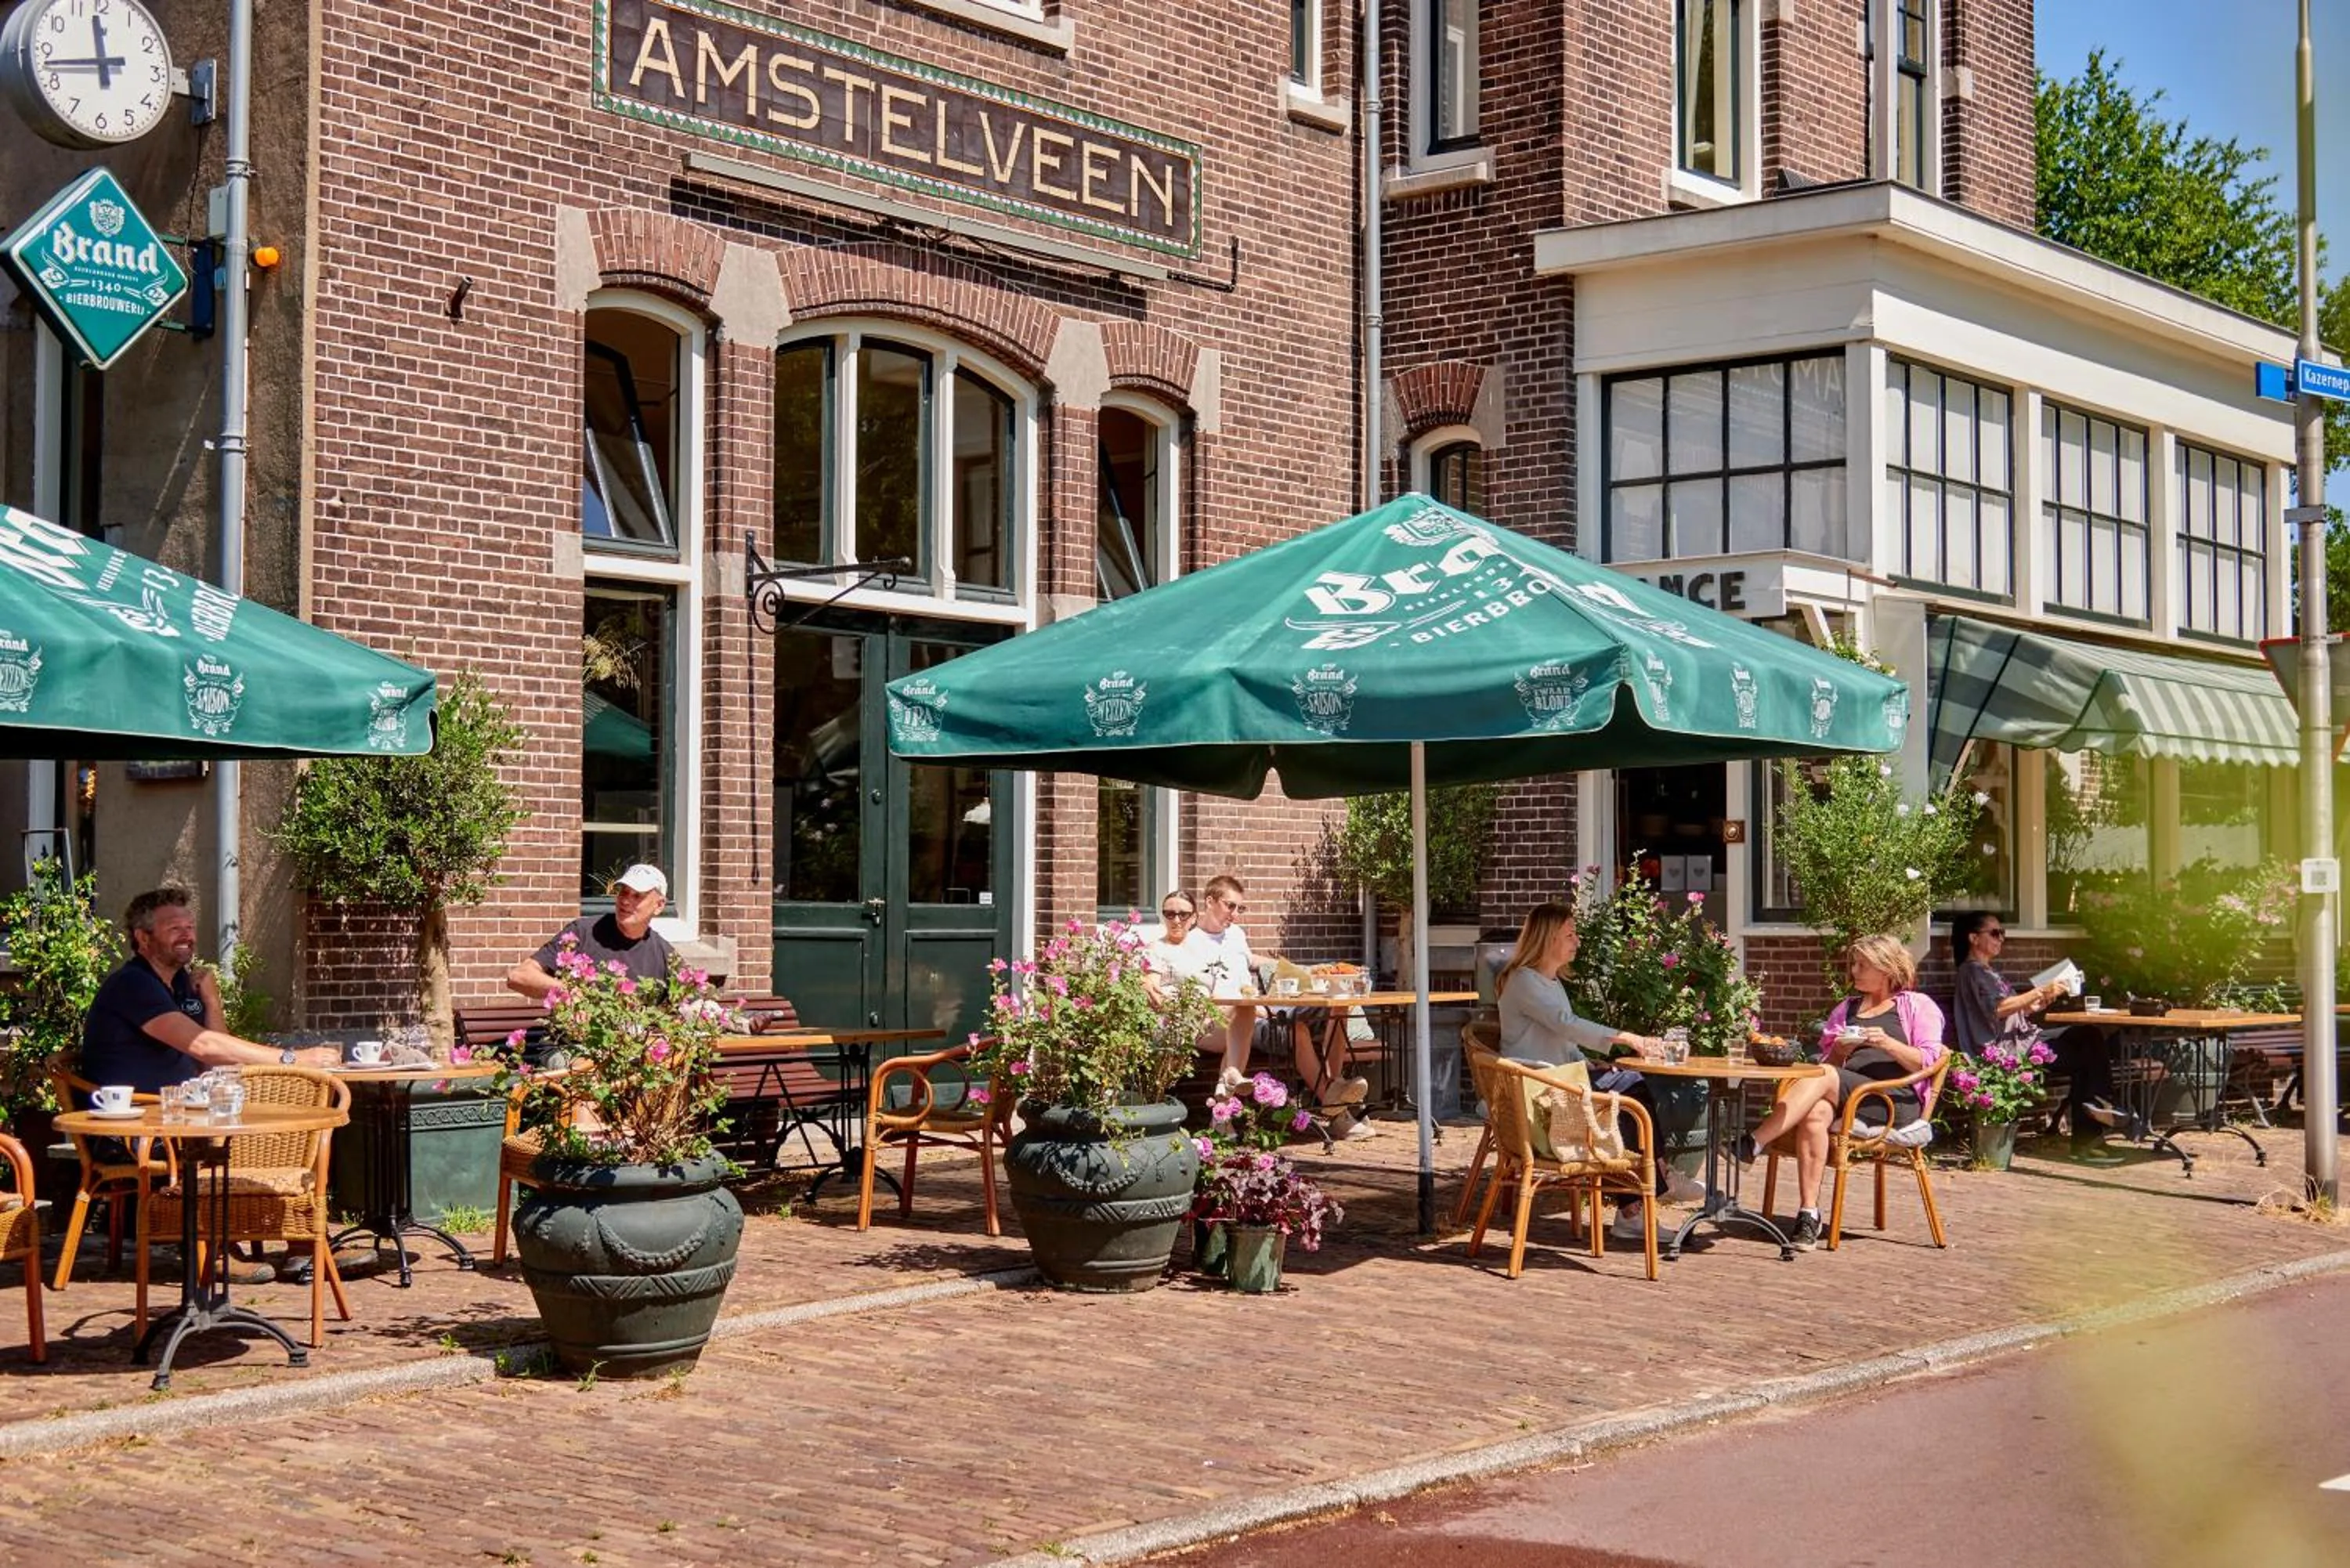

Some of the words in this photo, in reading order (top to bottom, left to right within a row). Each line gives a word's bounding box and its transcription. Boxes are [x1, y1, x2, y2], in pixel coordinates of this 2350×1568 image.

[51, 14, 65, 33] 10
[41, 42, 52, 59] 9
[142, 36, 154, 54] 2
[49, 73, 60, 90] 8
[150, 65, 161, 82] 3
[69, 96, 81, 114] 7
[140, 92, 153, 110] 4
[95, 112, 107, 129] 6
[125, 109, 136, 126] 5
[629, 17, 1174, 228] AMSTELVEEN
[52, 221, 160, 276] Brand
[92, 278, 122, 294] 1340
[2304, 367, 2350, 396] Kazernep
[1638, 571, 1746, 611] NCE
[1411, 579, 1553, 643] BIERBRO
[904, 705, 935, 728] IPA
